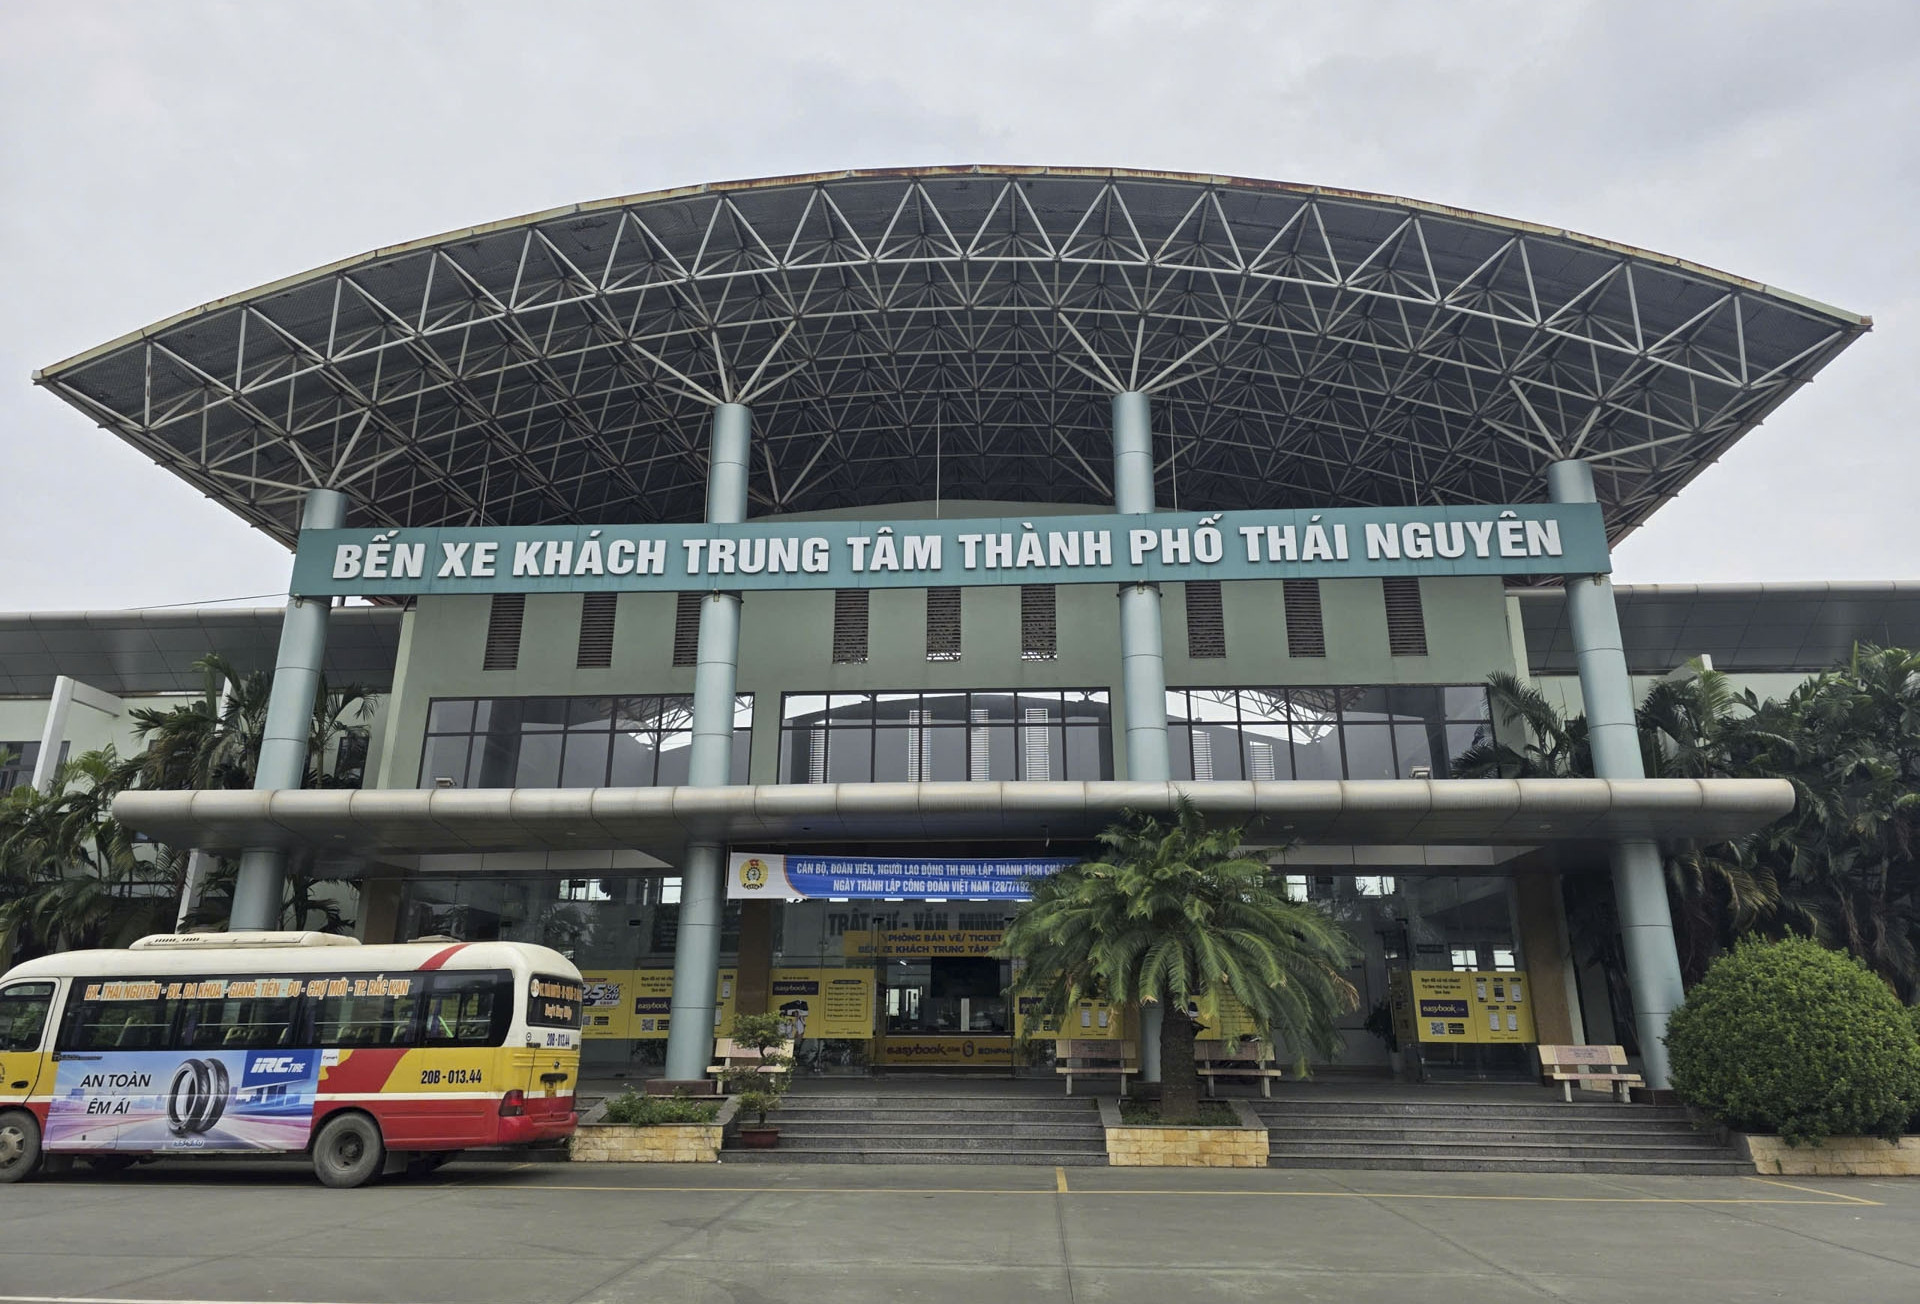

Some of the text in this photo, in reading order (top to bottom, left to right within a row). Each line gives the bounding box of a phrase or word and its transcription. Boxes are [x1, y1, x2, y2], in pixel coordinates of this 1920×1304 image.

[332, 510, 1564, 579] BẾN XE KHÁCH TRUNG TÂM THÀNH PHỐ THÁI NGUYÊN
[797, 861, 814, 874] CÁN
[830, 861, 853, 875] ĐOÀN
[878, 862, 903, 875] NGƯỜI
[904, 864, 919, 875] LAO
[921, 863, 943, 878] ĐỘNG
[946, 864, 958, 876] THI
[960, 864, 977, 876] ĐUA
[978, 862, 993, 878] LẬP
[996, 862, 1022, 876] THÀNH
[1024, 861, 1043, 876] TÍCH
[833, 878, 855, 892] NGÀY
[857, 878, 883, 892] THÀNH
[885, 878, 901, 894] LẬP
[903, 878, 925, 892] CÔNG
[927, 878, 949, 892] ĐOÀN
[951, 879, 968, 894] VIỆT
[971, 881, 990, 892] NAM
[958, 911, 1005, 931] MINH
[888, 931, 921, 942] PHÒNG
[924, 932, 945, 942] BÁN
[969, 934, 1002, 942] TICKET
[896, 943, 929, 953] KHÁCH
[933, 945, 965, 953] TRUNG
[968, 944, 989, 953] TÂM
[228, 981, 258, 998] GIANG
[250, 1057, 294, 1073] IRC
[80, 1071, 151, 1087] AN TOÀN
[87, 1098, 131, 1114] ÊM ÁI
